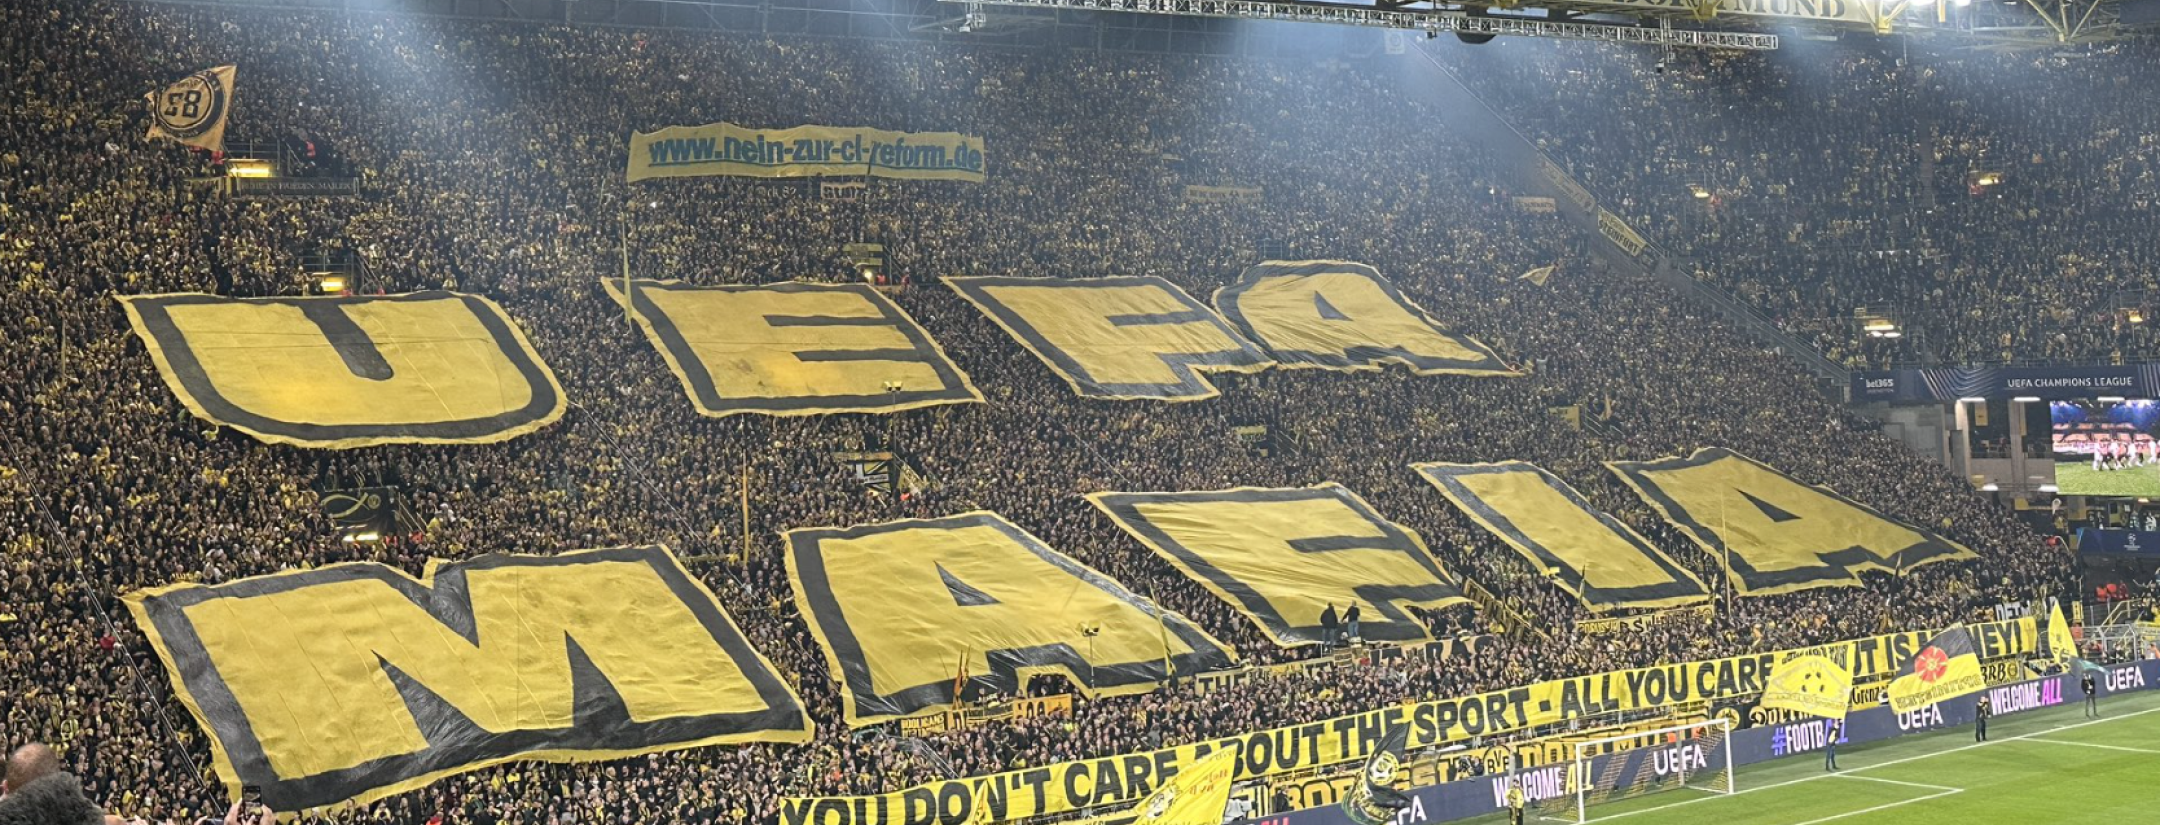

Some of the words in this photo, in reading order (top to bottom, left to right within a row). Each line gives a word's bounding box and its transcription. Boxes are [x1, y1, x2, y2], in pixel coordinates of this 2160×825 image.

[650, 133, 983, 170] www.nein-zur-cl-reform.de
[128, 261, 1518, 444] UEFA
[2007, 378, 2033, 388] UEFA
[2035, 377, 2091, 388] CHAMPIONS
[2093, 376, 2133, 387] LEAGUE
[138, 447, 1972, 811] MAFIA
[1989, 681, 2041, 716] WELCOME
[2042, 678, 2063, 704] ALL
[2105, 665, 2145, 692] UEFA
[783, 797, 888, 825] YOU
[903, 769, 1056, 825] DON'T
[1064, 749, 1179, 808] CARE
[1333, 706, 1404, 759] THE
[1414, 688, 1529, 744] SPORT
[1561, 674, 1619, 720] ALL
[1625, 664, 1689, 709] YOU
[1696, 653, 1774, 698] CARE
[1884, 632, 1912, 671] IS
[1898, 702, 1944, 730] UEFA
[1654, 745, 1707, 775] UEFA
[1492, 767, 1563, 808] WCOME
